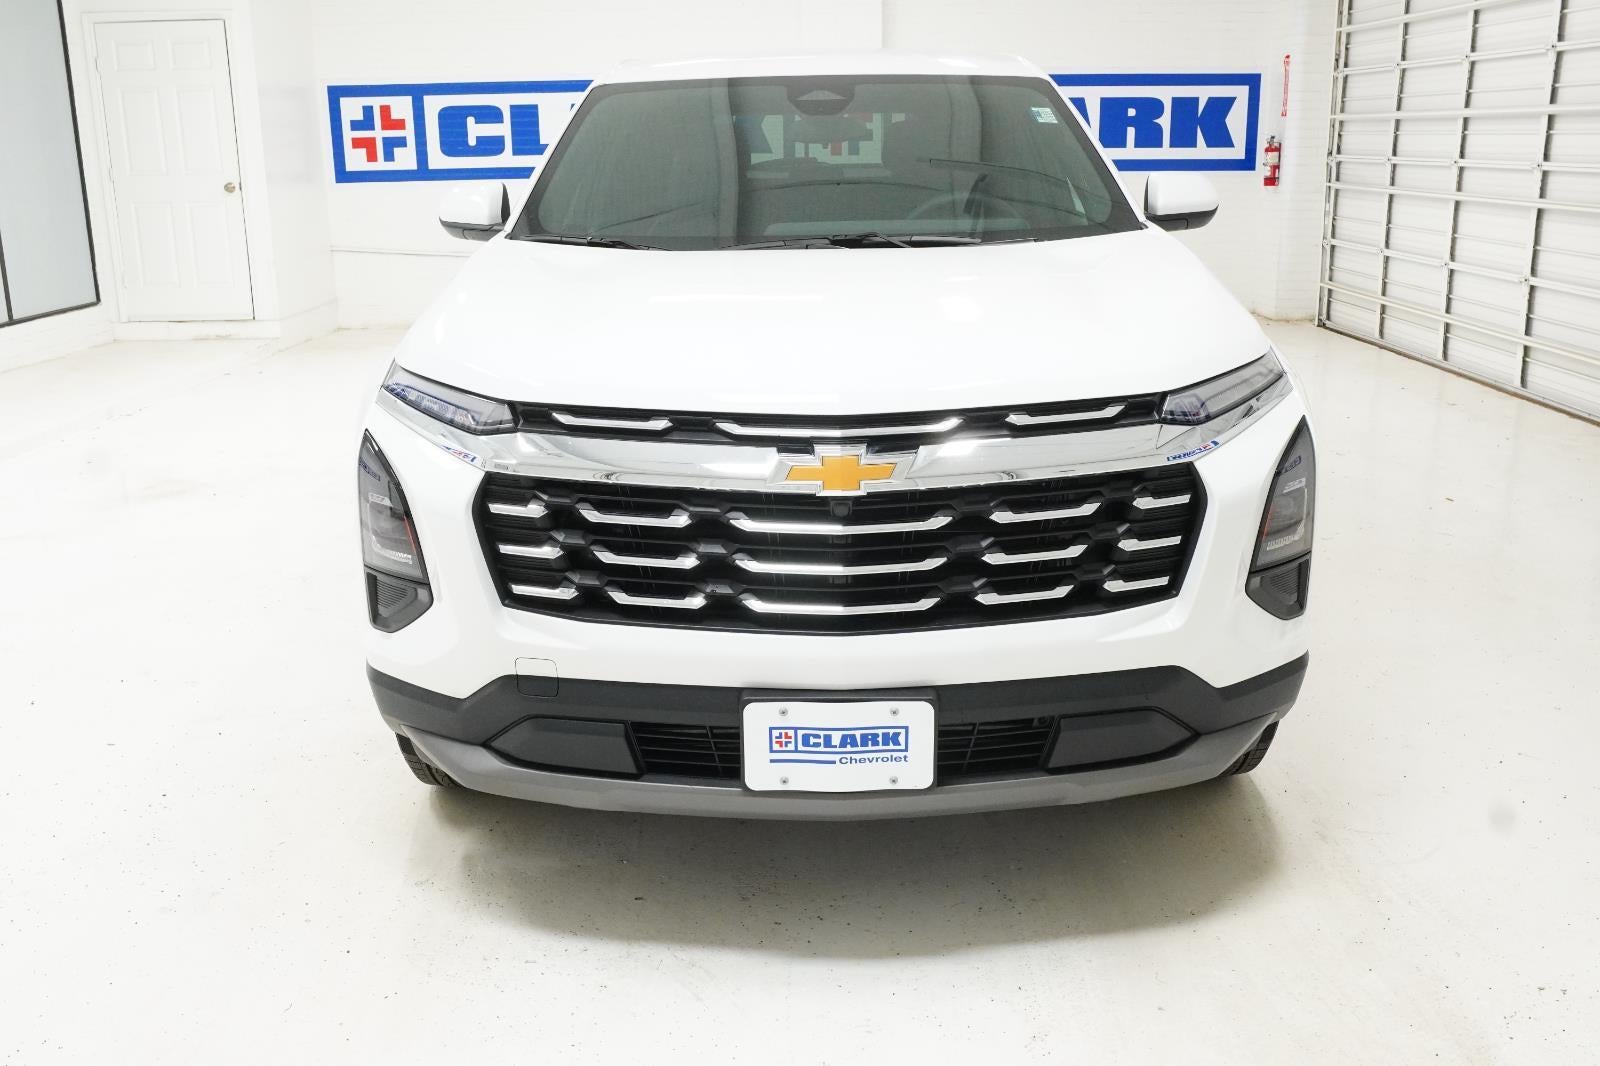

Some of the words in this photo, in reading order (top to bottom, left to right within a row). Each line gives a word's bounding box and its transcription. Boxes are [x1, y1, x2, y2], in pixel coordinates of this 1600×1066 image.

[437, 104, 577, 157] CL
[801, 731, 902, 749] CLARK
[838, 754, 909, 765] Chevrolet
